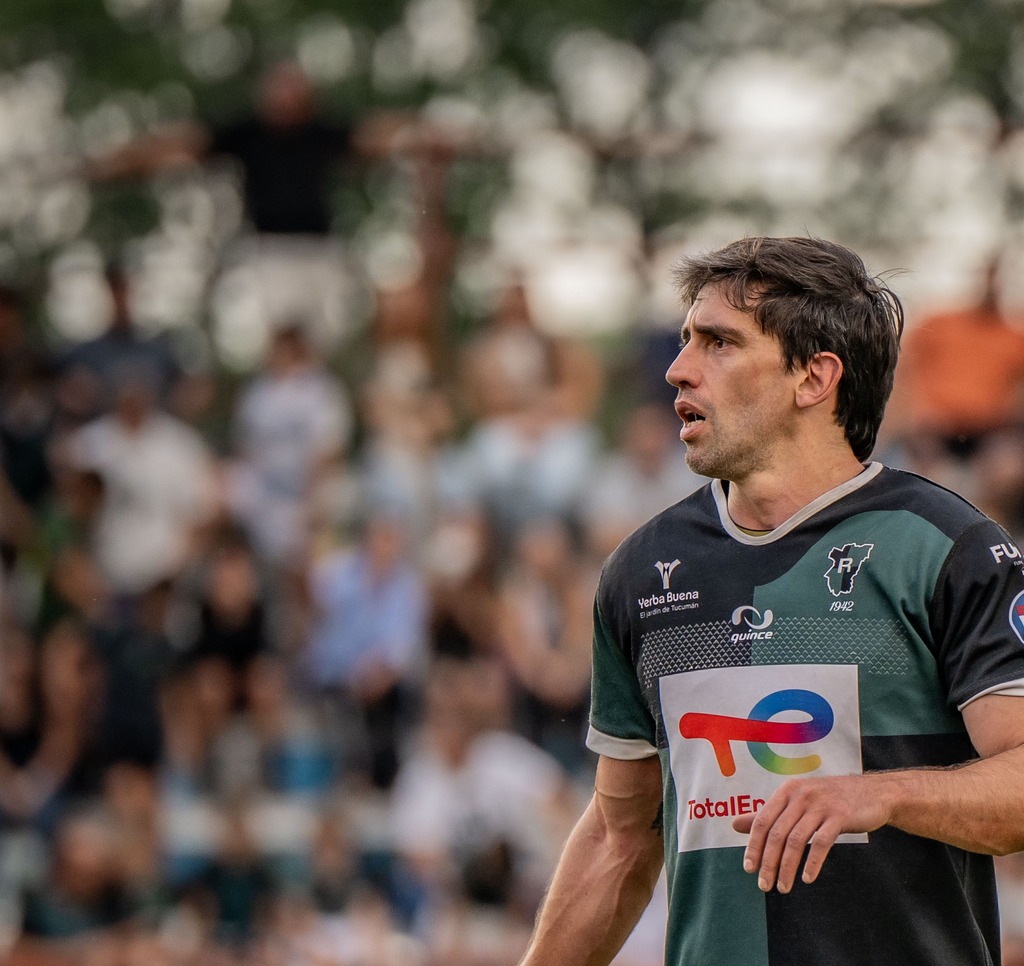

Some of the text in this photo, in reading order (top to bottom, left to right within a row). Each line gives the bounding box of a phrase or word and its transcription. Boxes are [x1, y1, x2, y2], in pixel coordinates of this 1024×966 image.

[638, 591, 699, 609] Yerba Buena
[829, 601, 854, 612] 1942
[730, 628, 773, 644] quince
[688, 795, 766, 820] TotalEn
